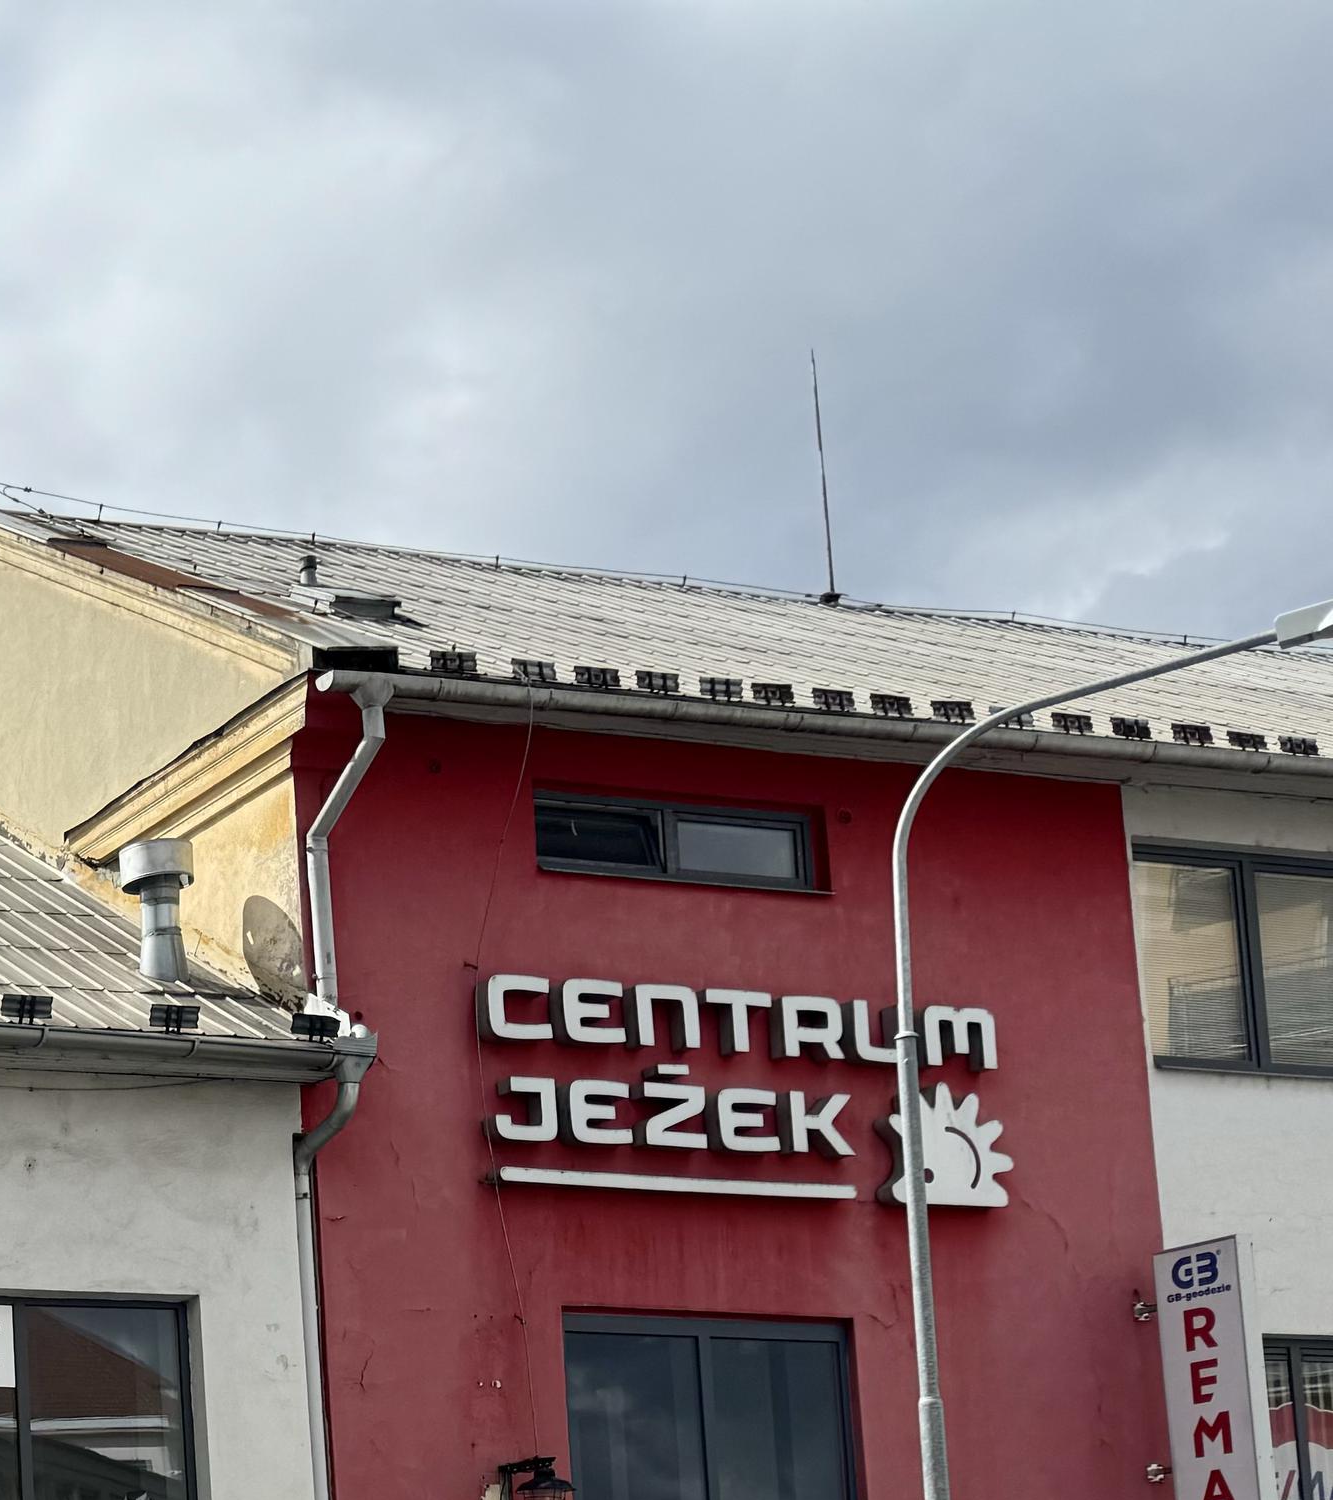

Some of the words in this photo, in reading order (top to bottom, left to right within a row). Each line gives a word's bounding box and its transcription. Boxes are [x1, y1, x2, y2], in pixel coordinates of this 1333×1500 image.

[486, 974, 998, 1070] CENTRUM
[495, 1063, 856, 1156] JEŽEK
[1166, 1284, 1232, 1303] GB-geodezie
